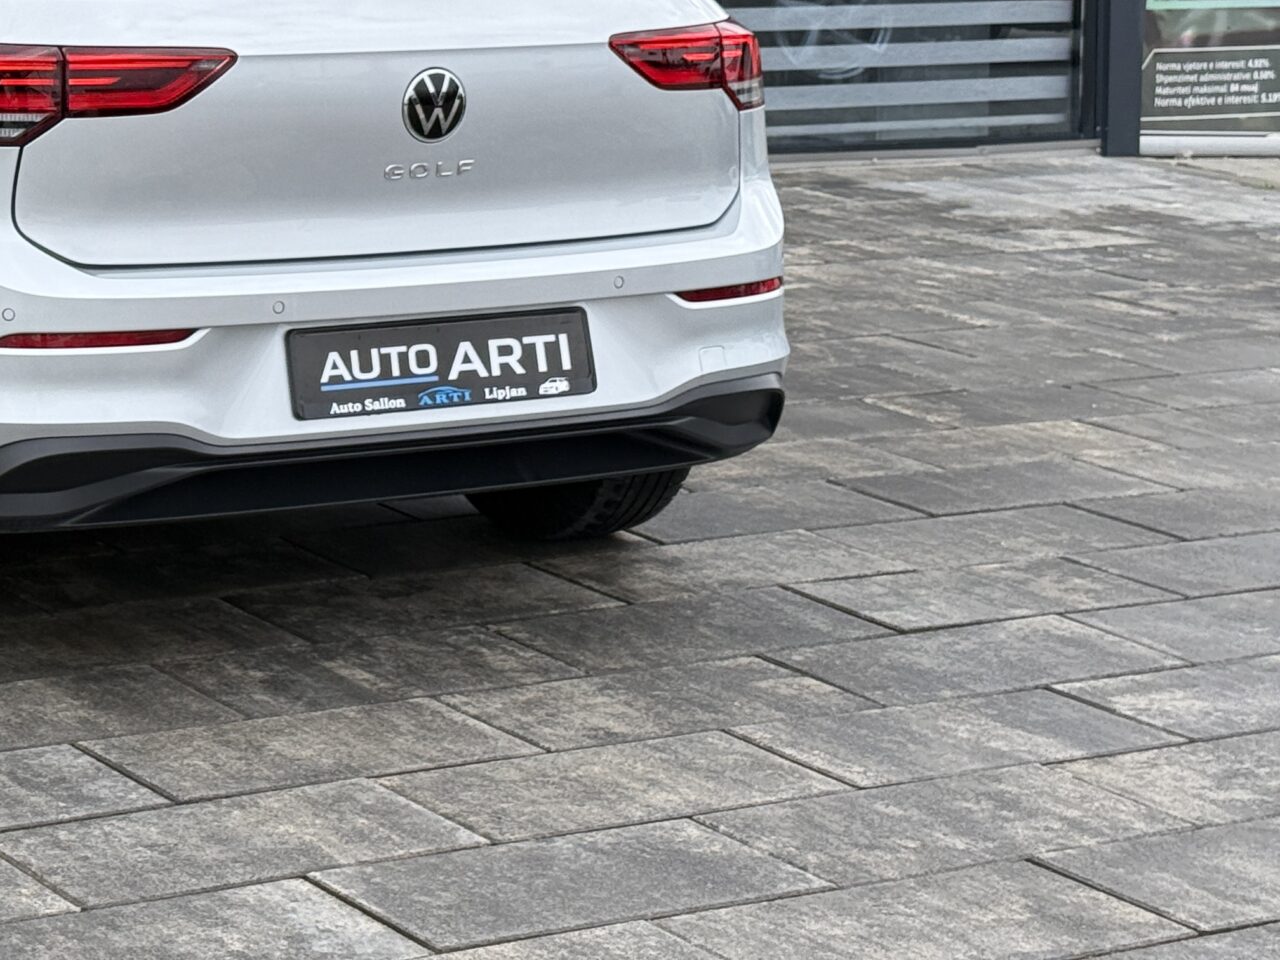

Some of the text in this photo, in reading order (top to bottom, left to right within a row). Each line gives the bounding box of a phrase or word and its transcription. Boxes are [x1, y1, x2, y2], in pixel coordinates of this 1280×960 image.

[1154, 97, 1182, 107] Norma
[384, 159, 475, 180] GOLF
[320, 333, 572, 383] AUTO ARTI
[330, 386, 528, 415] Auto Sallon ARTI Lipjan
